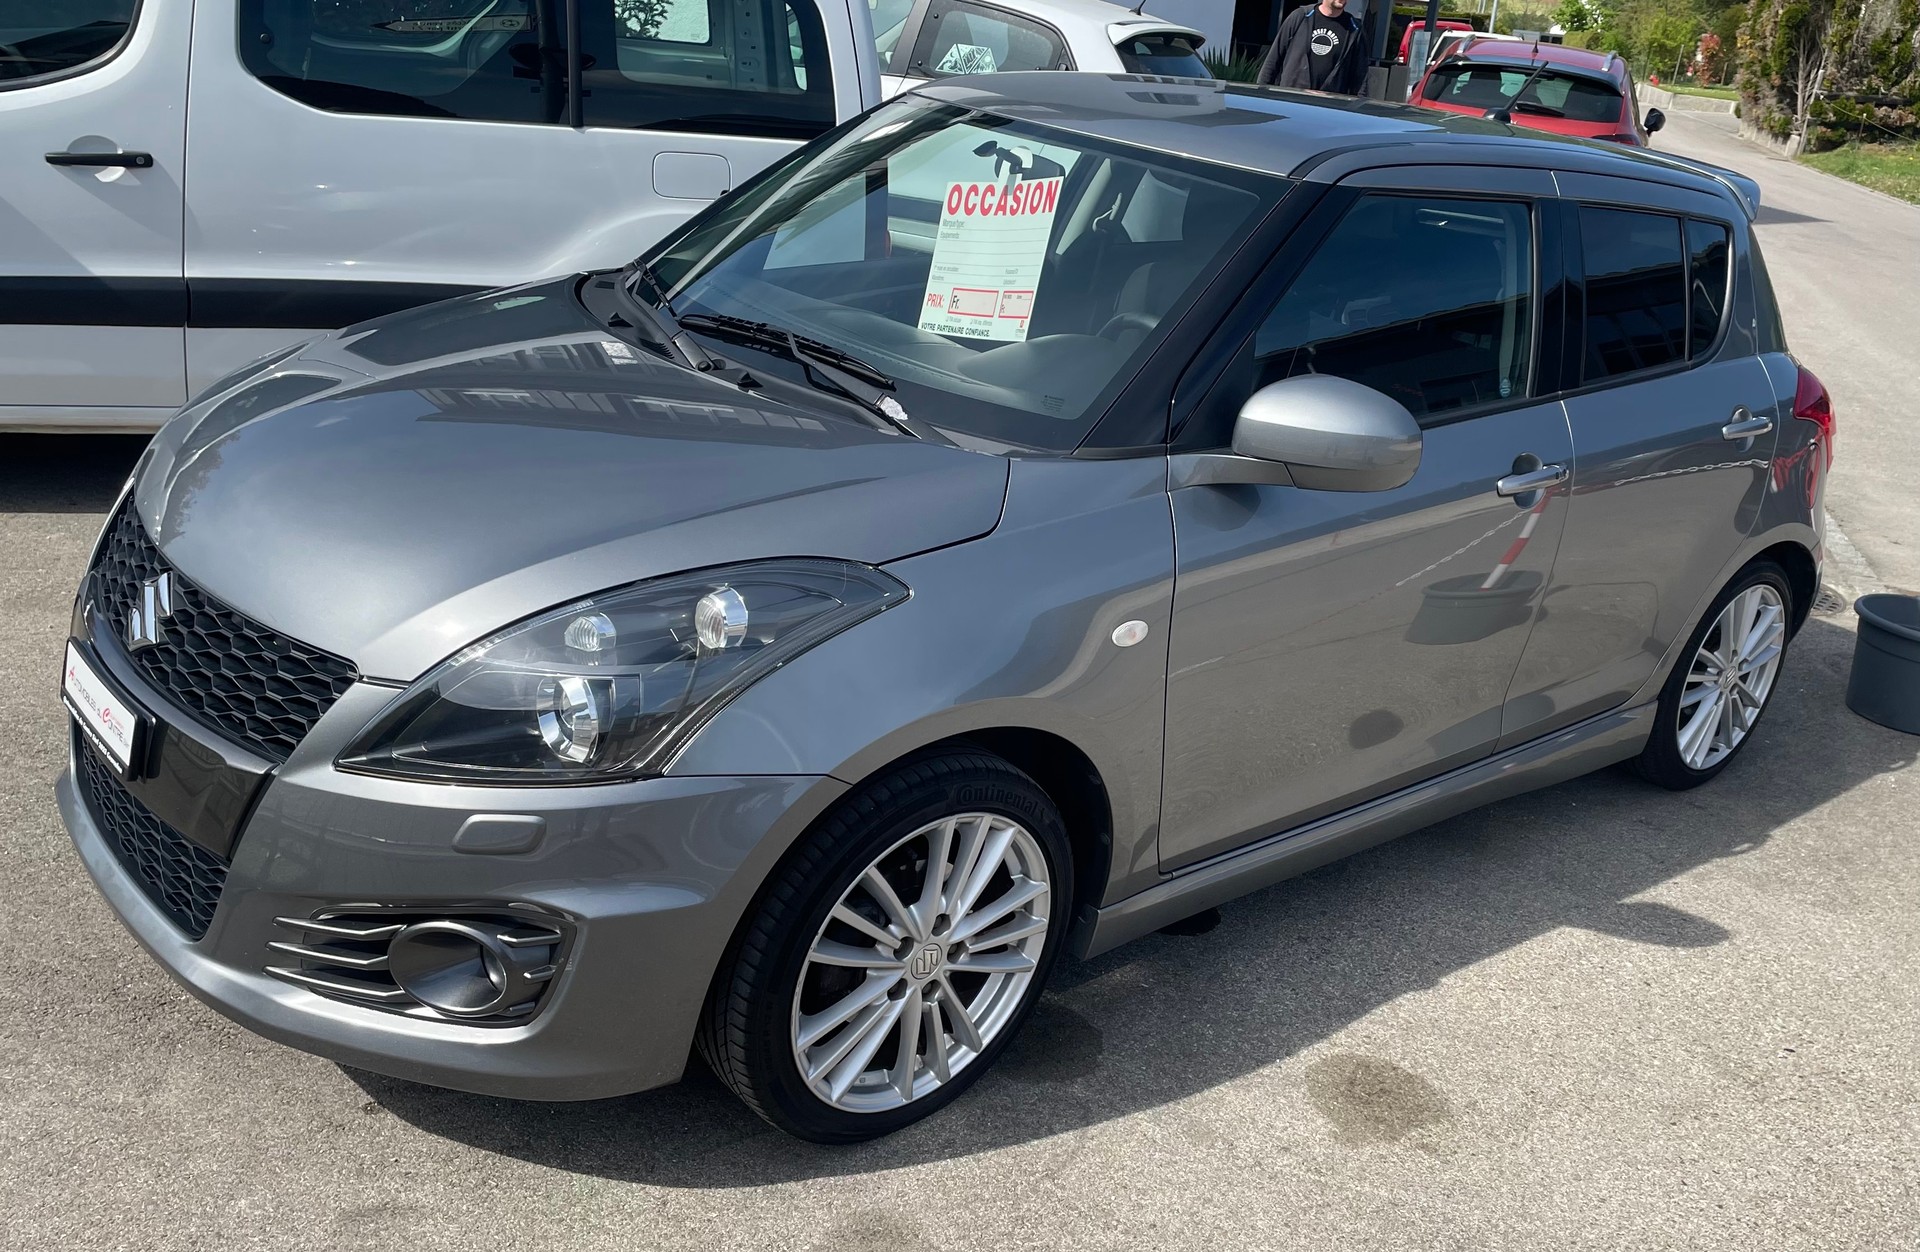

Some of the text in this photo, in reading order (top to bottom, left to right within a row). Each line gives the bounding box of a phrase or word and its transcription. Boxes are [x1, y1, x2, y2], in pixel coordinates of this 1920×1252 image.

[946, 179, 1060, 217] OCCASION
[926, 293, 960, 309] PRIX: Fr.
[921, 322, 936, 331] VOTRE
[936, 324, 964, 334] PARTENAIRE
[955, 783, 1038, 815] Continental
